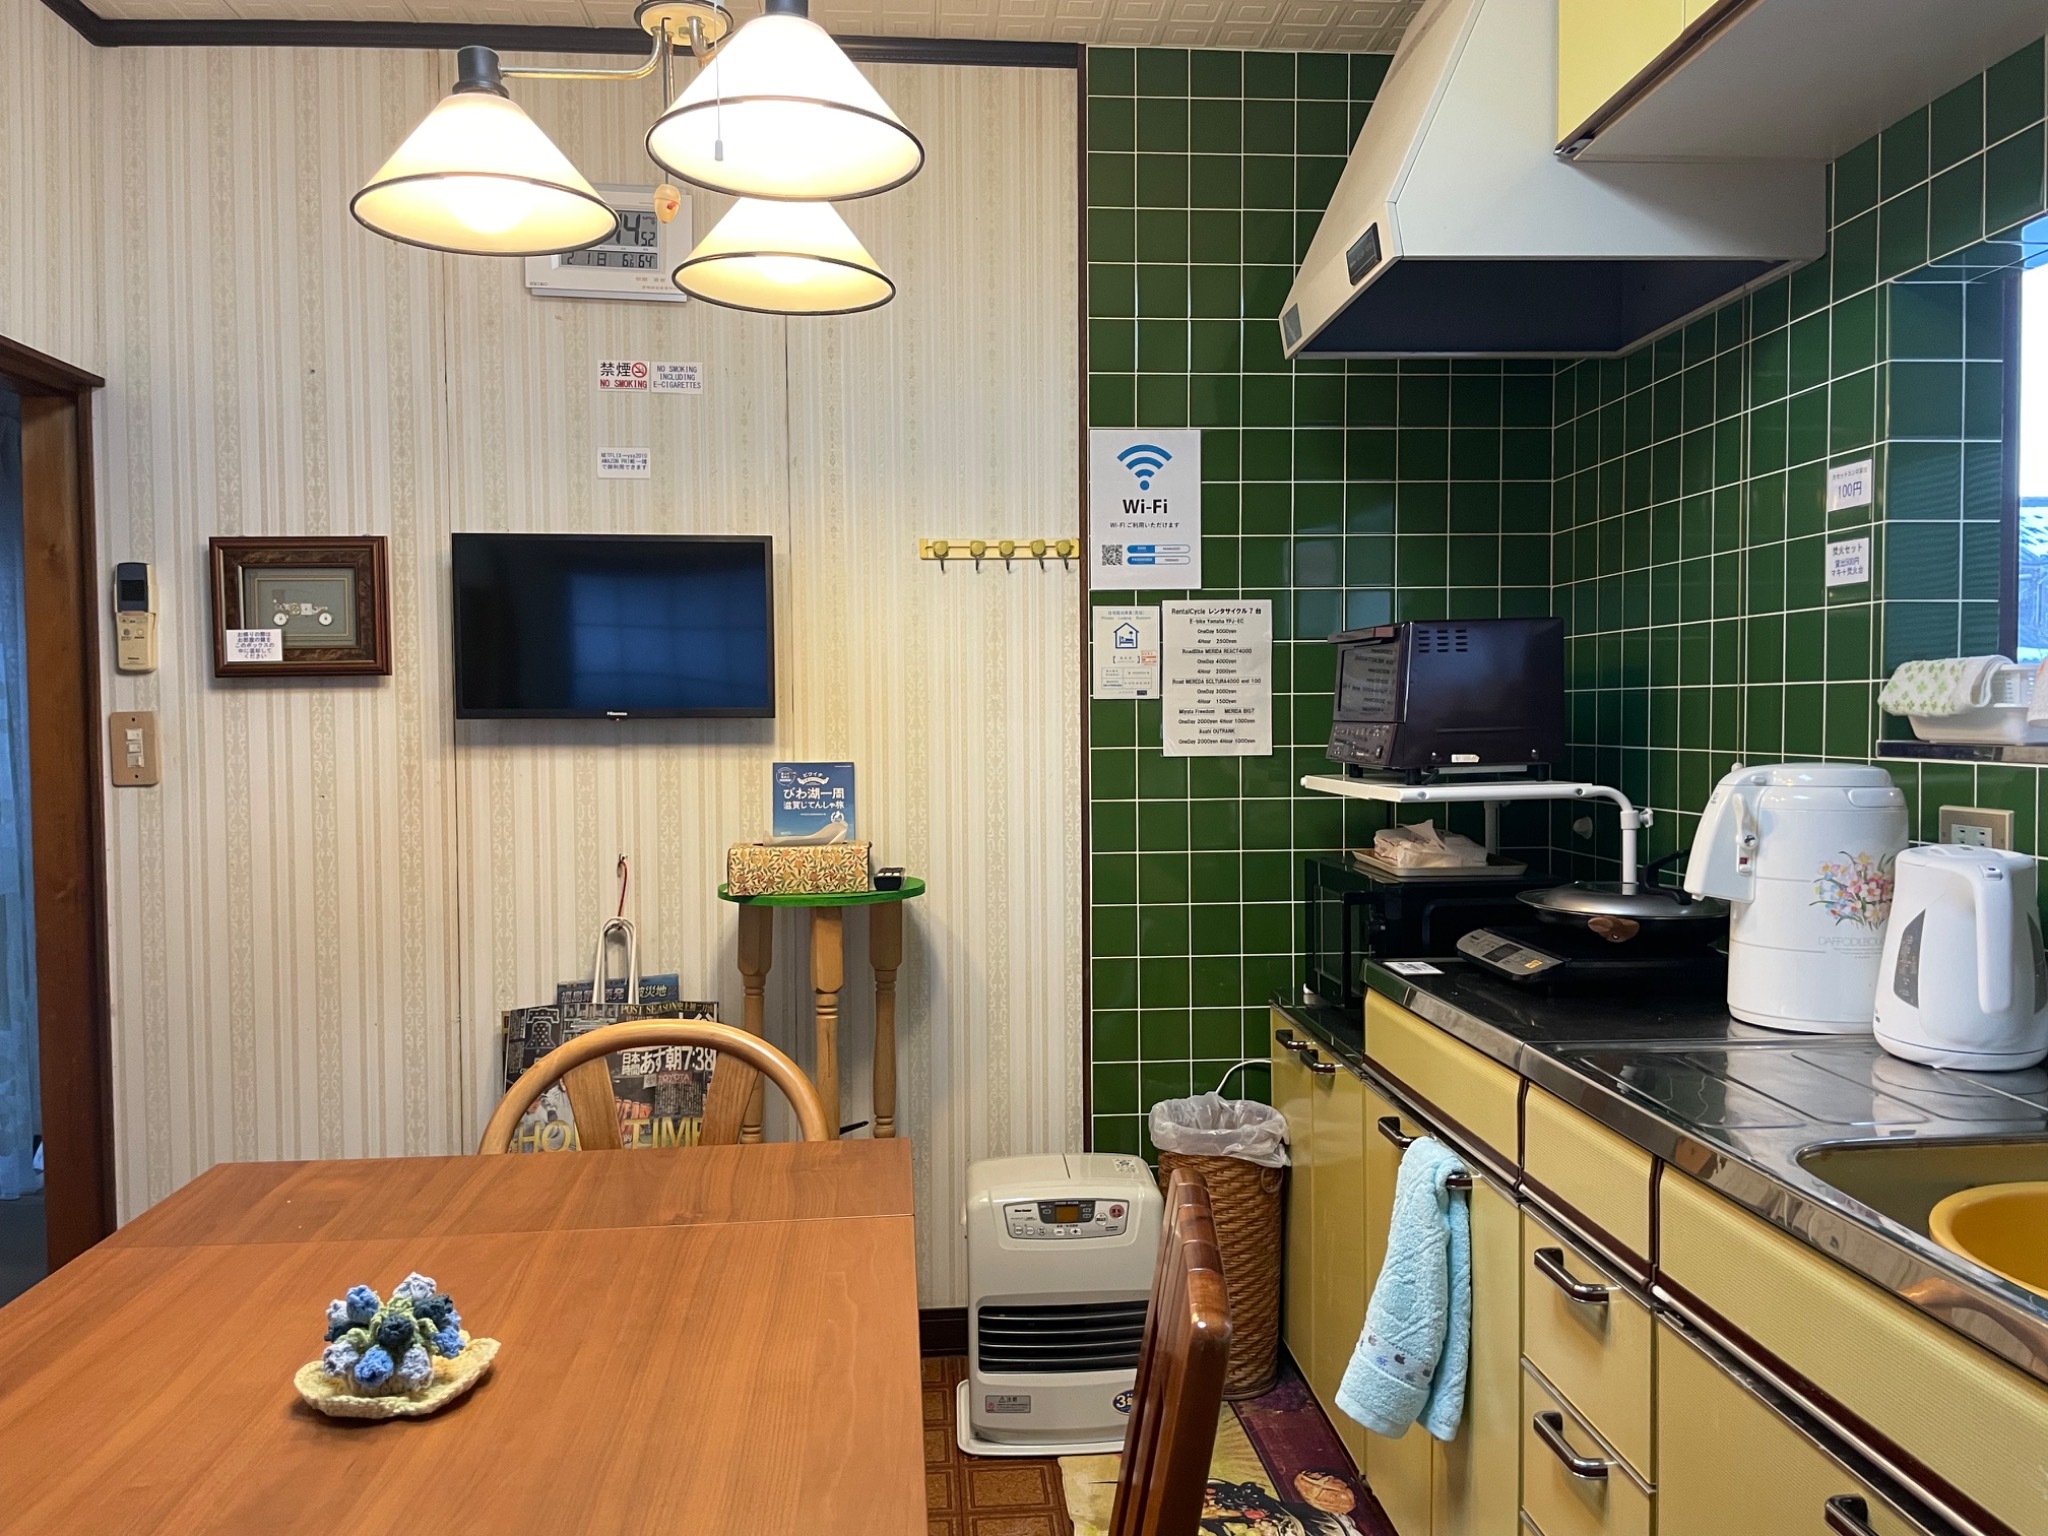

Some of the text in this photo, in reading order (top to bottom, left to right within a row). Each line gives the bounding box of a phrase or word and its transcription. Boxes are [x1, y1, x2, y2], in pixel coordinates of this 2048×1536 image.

[641, 232, 655, 246] 52
[600, 362, 631, 377] 禁煙
[615, 380, 647, 388] SMOKING
[1838, 481, 1862, 498] 100円
[1123, 499, 1168, 513] Wi-Fi
[783, 787, 844, 799] びわ湖一周
[784, 801, 844, 810] 滋賀じてんしゃ旅
[621, 1005, 641, 1015] POST
[622, 1053, 640, 1064] 日本
[622, 1064, 640, 1075] 時間
